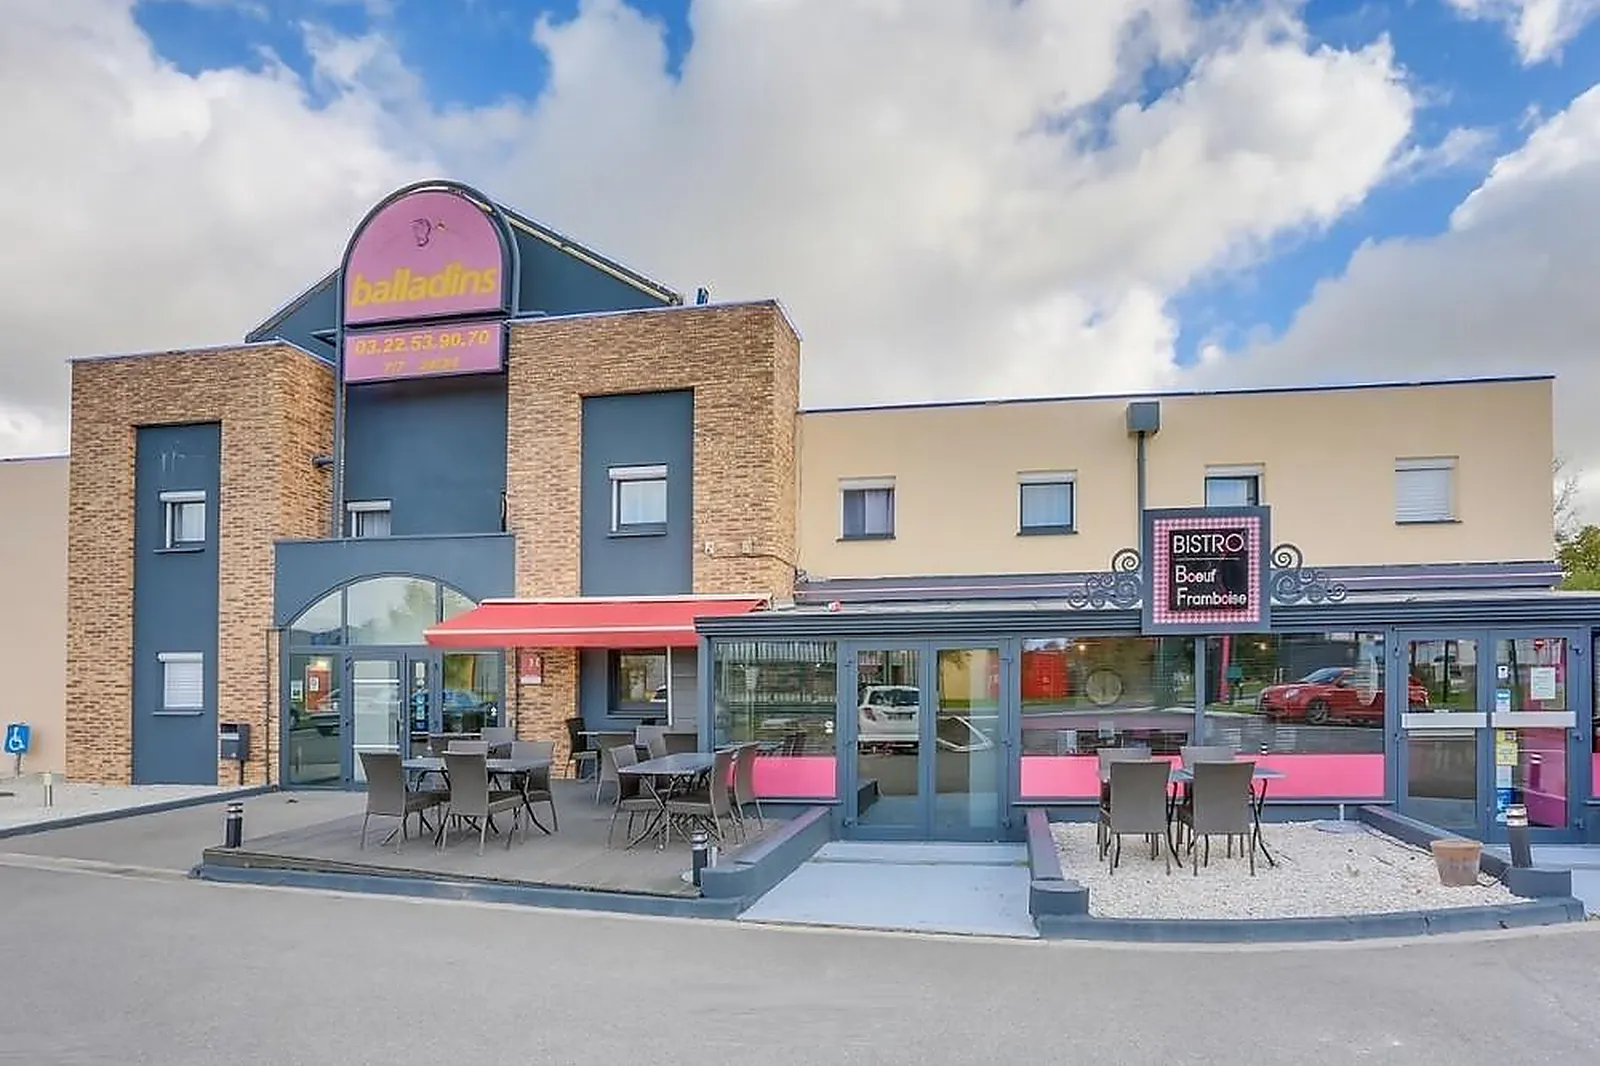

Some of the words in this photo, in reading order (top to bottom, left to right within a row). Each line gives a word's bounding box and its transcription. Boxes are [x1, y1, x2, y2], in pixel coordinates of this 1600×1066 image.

[353, 261, 496, 306] balladins
[1173, 533, 1244, 553] BISTRO
[1177, 587, 1247, 606] Framboise
